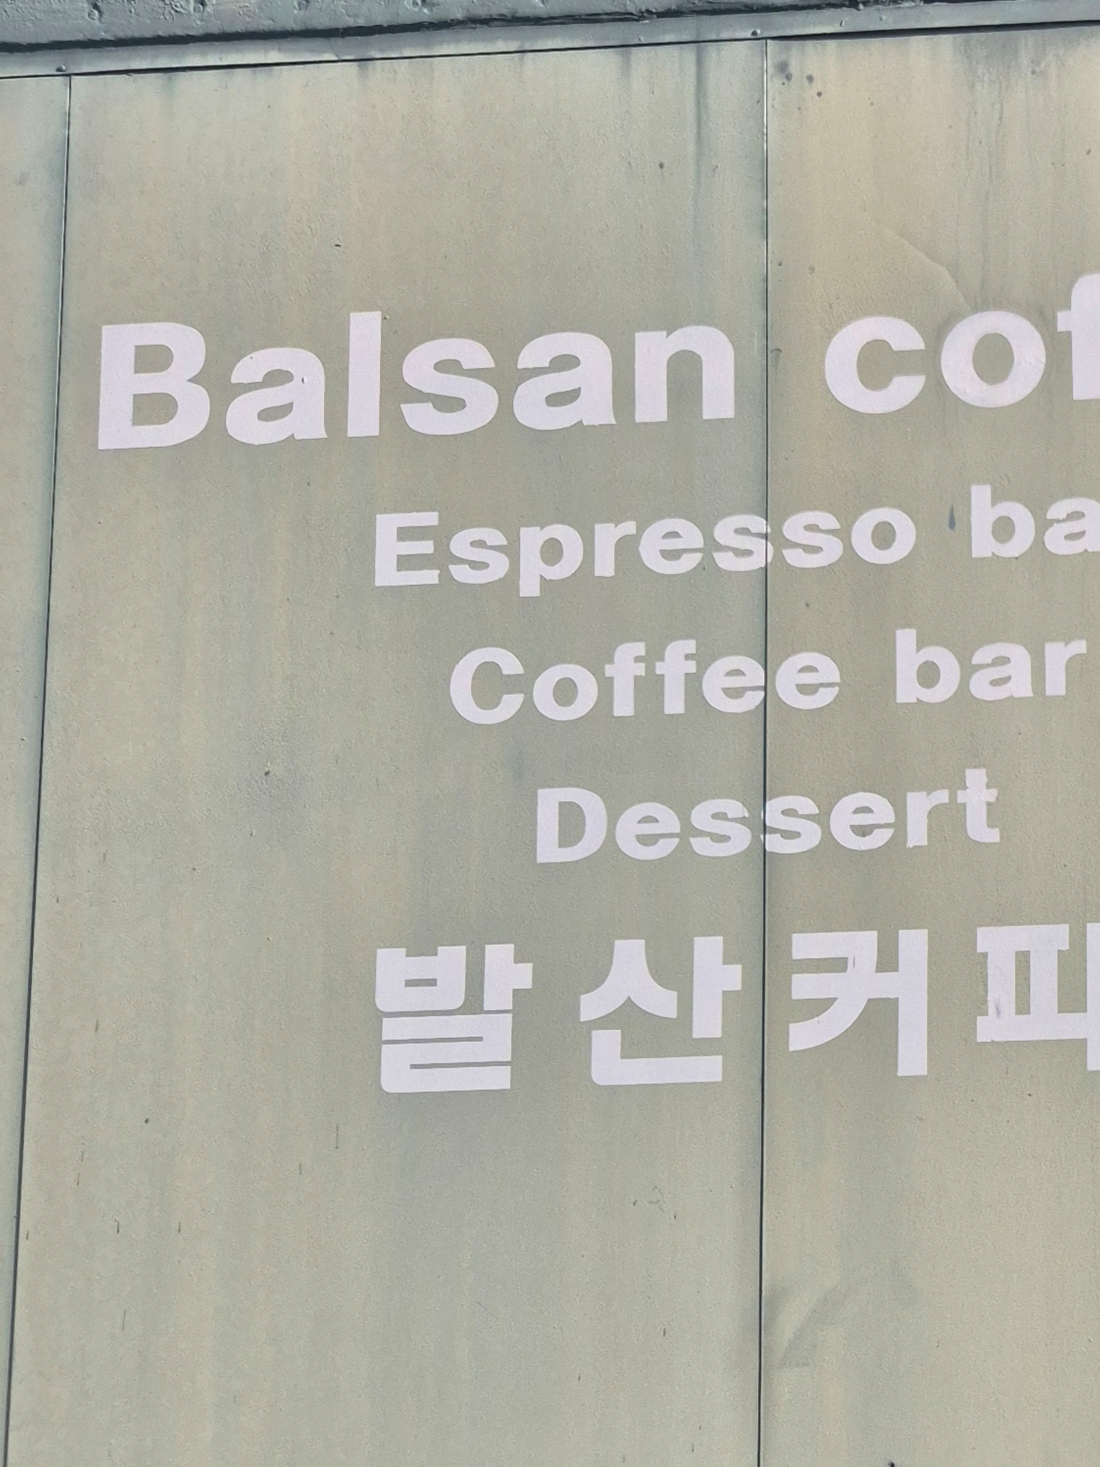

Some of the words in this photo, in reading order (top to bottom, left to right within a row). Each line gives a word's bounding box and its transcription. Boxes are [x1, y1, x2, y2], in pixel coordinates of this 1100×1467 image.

[97, 311, 734, 451] Balsan
[373, 507, 915, 598] Espresso
[448, 638, 840, 725] Coffee
[894, 628, 1087, 704] bar
[535, 768, 1000, 864] Dessert
